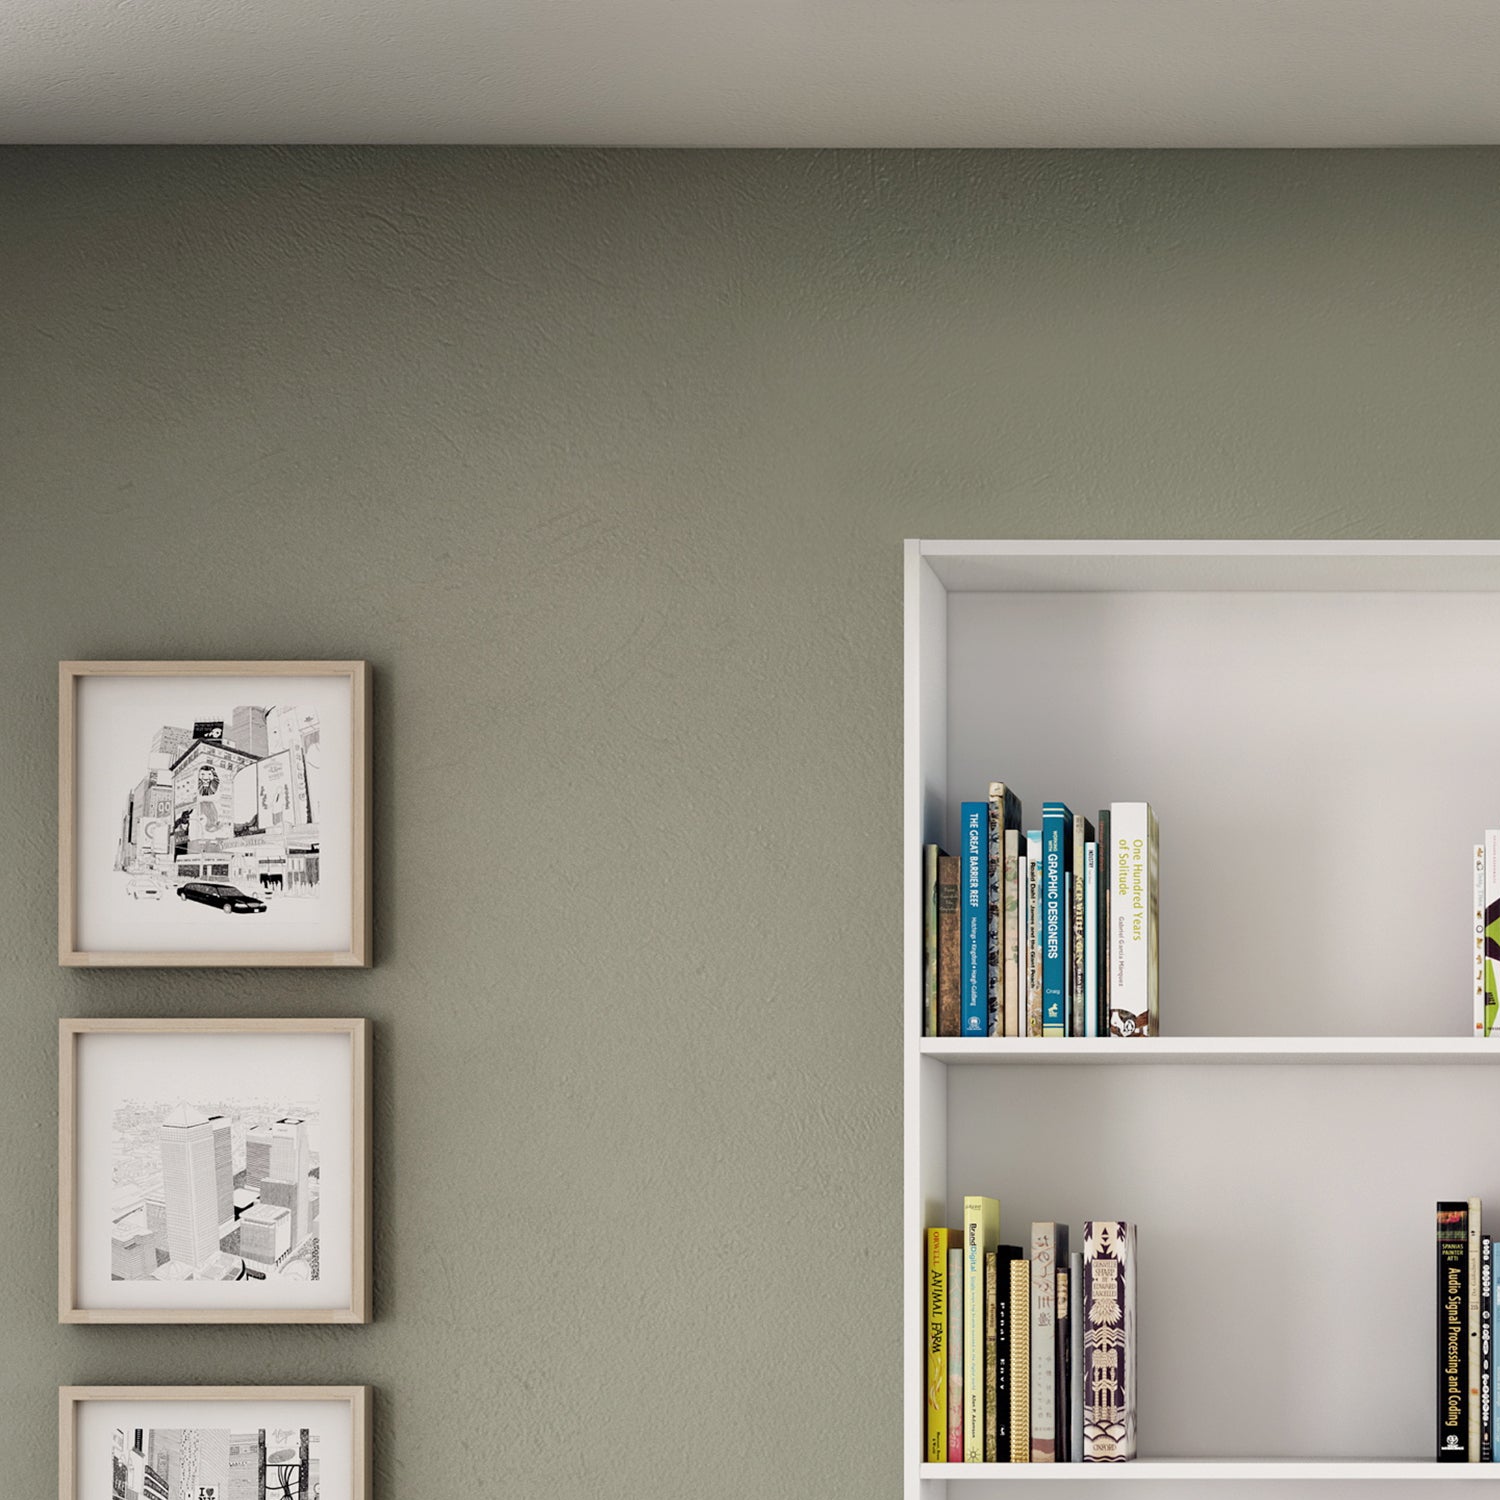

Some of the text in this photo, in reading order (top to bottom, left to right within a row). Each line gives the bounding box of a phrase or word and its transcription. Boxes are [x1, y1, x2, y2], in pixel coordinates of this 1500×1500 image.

[970, 813, 979, 907] THE GREAT BARRIER REEF
[1119, 839, 1129, 896] of Solitude
[1133, 839, 1143, 941] One Hundred Years
[1048, 854, 1058, 959] GRAPHIC DESIGNERS
[969, 1223, 977, 1272] BrandDigital
[931, 1270, 943, 1354] ANIMAL FARM
[1445, 1267, 1461, 1426] Audio Signal Processing and Coding
[199, 1487, 205, 1496] I
